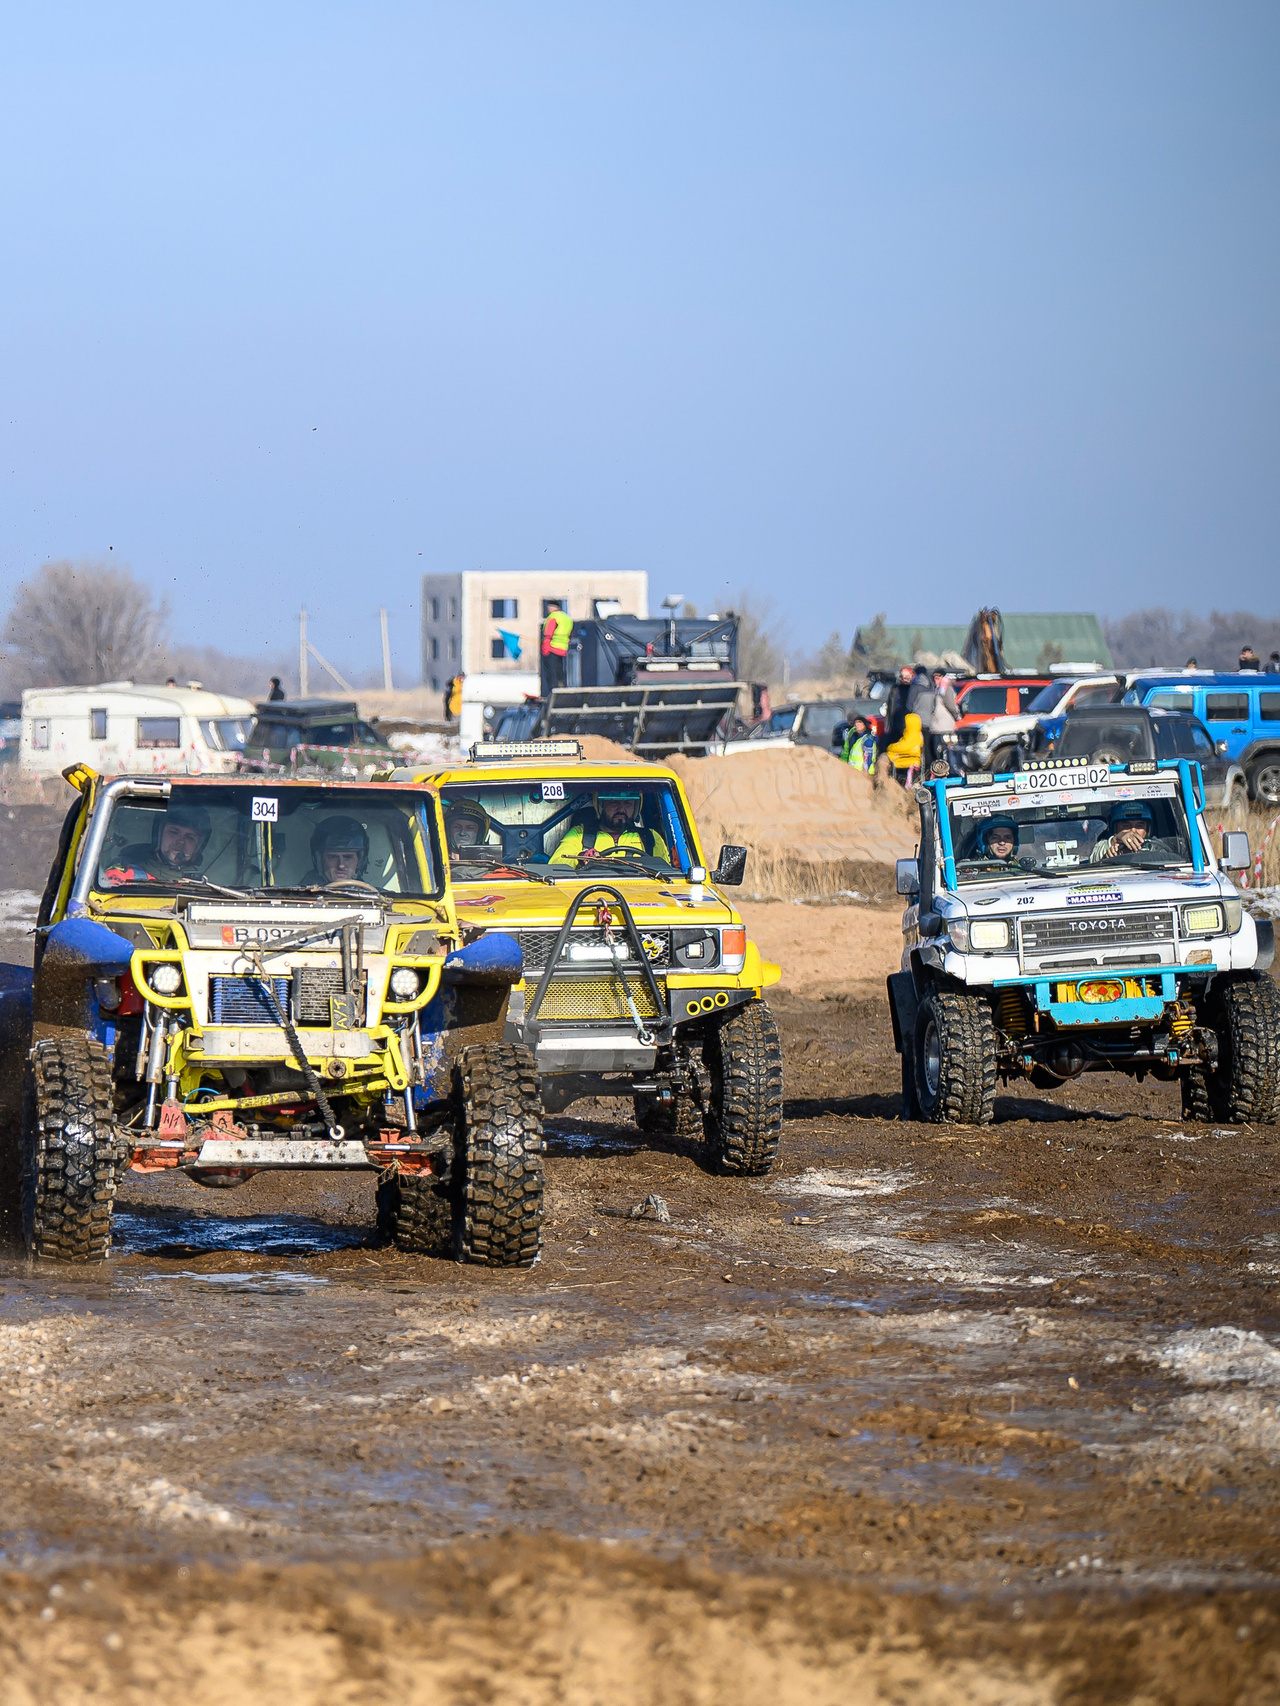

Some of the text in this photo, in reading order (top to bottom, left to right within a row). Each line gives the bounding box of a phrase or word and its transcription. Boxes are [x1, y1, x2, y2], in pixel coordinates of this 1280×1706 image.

[543, 785, 563, 797] 208
[253, 801, 276, 817] 304
[1016, 897, 1035, 905] 202
[1070, 893, 1119, 904] MARSHAL
[1070, 918, 1127, 931] TOYOTA
[235, 928, 249, 942] B
